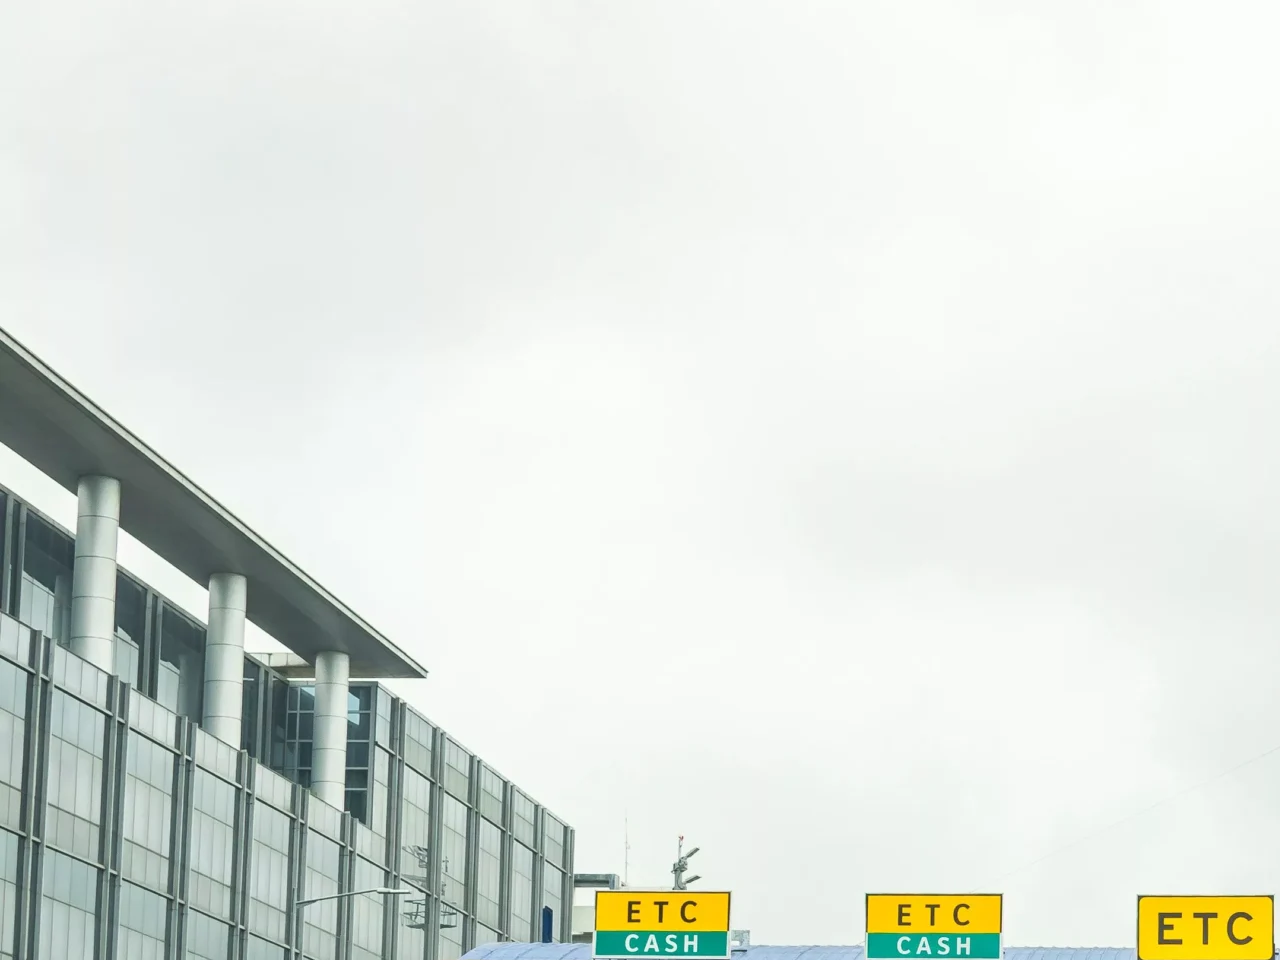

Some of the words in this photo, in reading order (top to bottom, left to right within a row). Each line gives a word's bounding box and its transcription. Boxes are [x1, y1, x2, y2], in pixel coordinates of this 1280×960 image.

[627, 900, 698, 924] ETC
[897, 903, 971, 926] ETC
[1157, 911, 1254, 945] ETC
[624, 934, 699, 953] CASH
[896, 936, 971, 955] CASH
